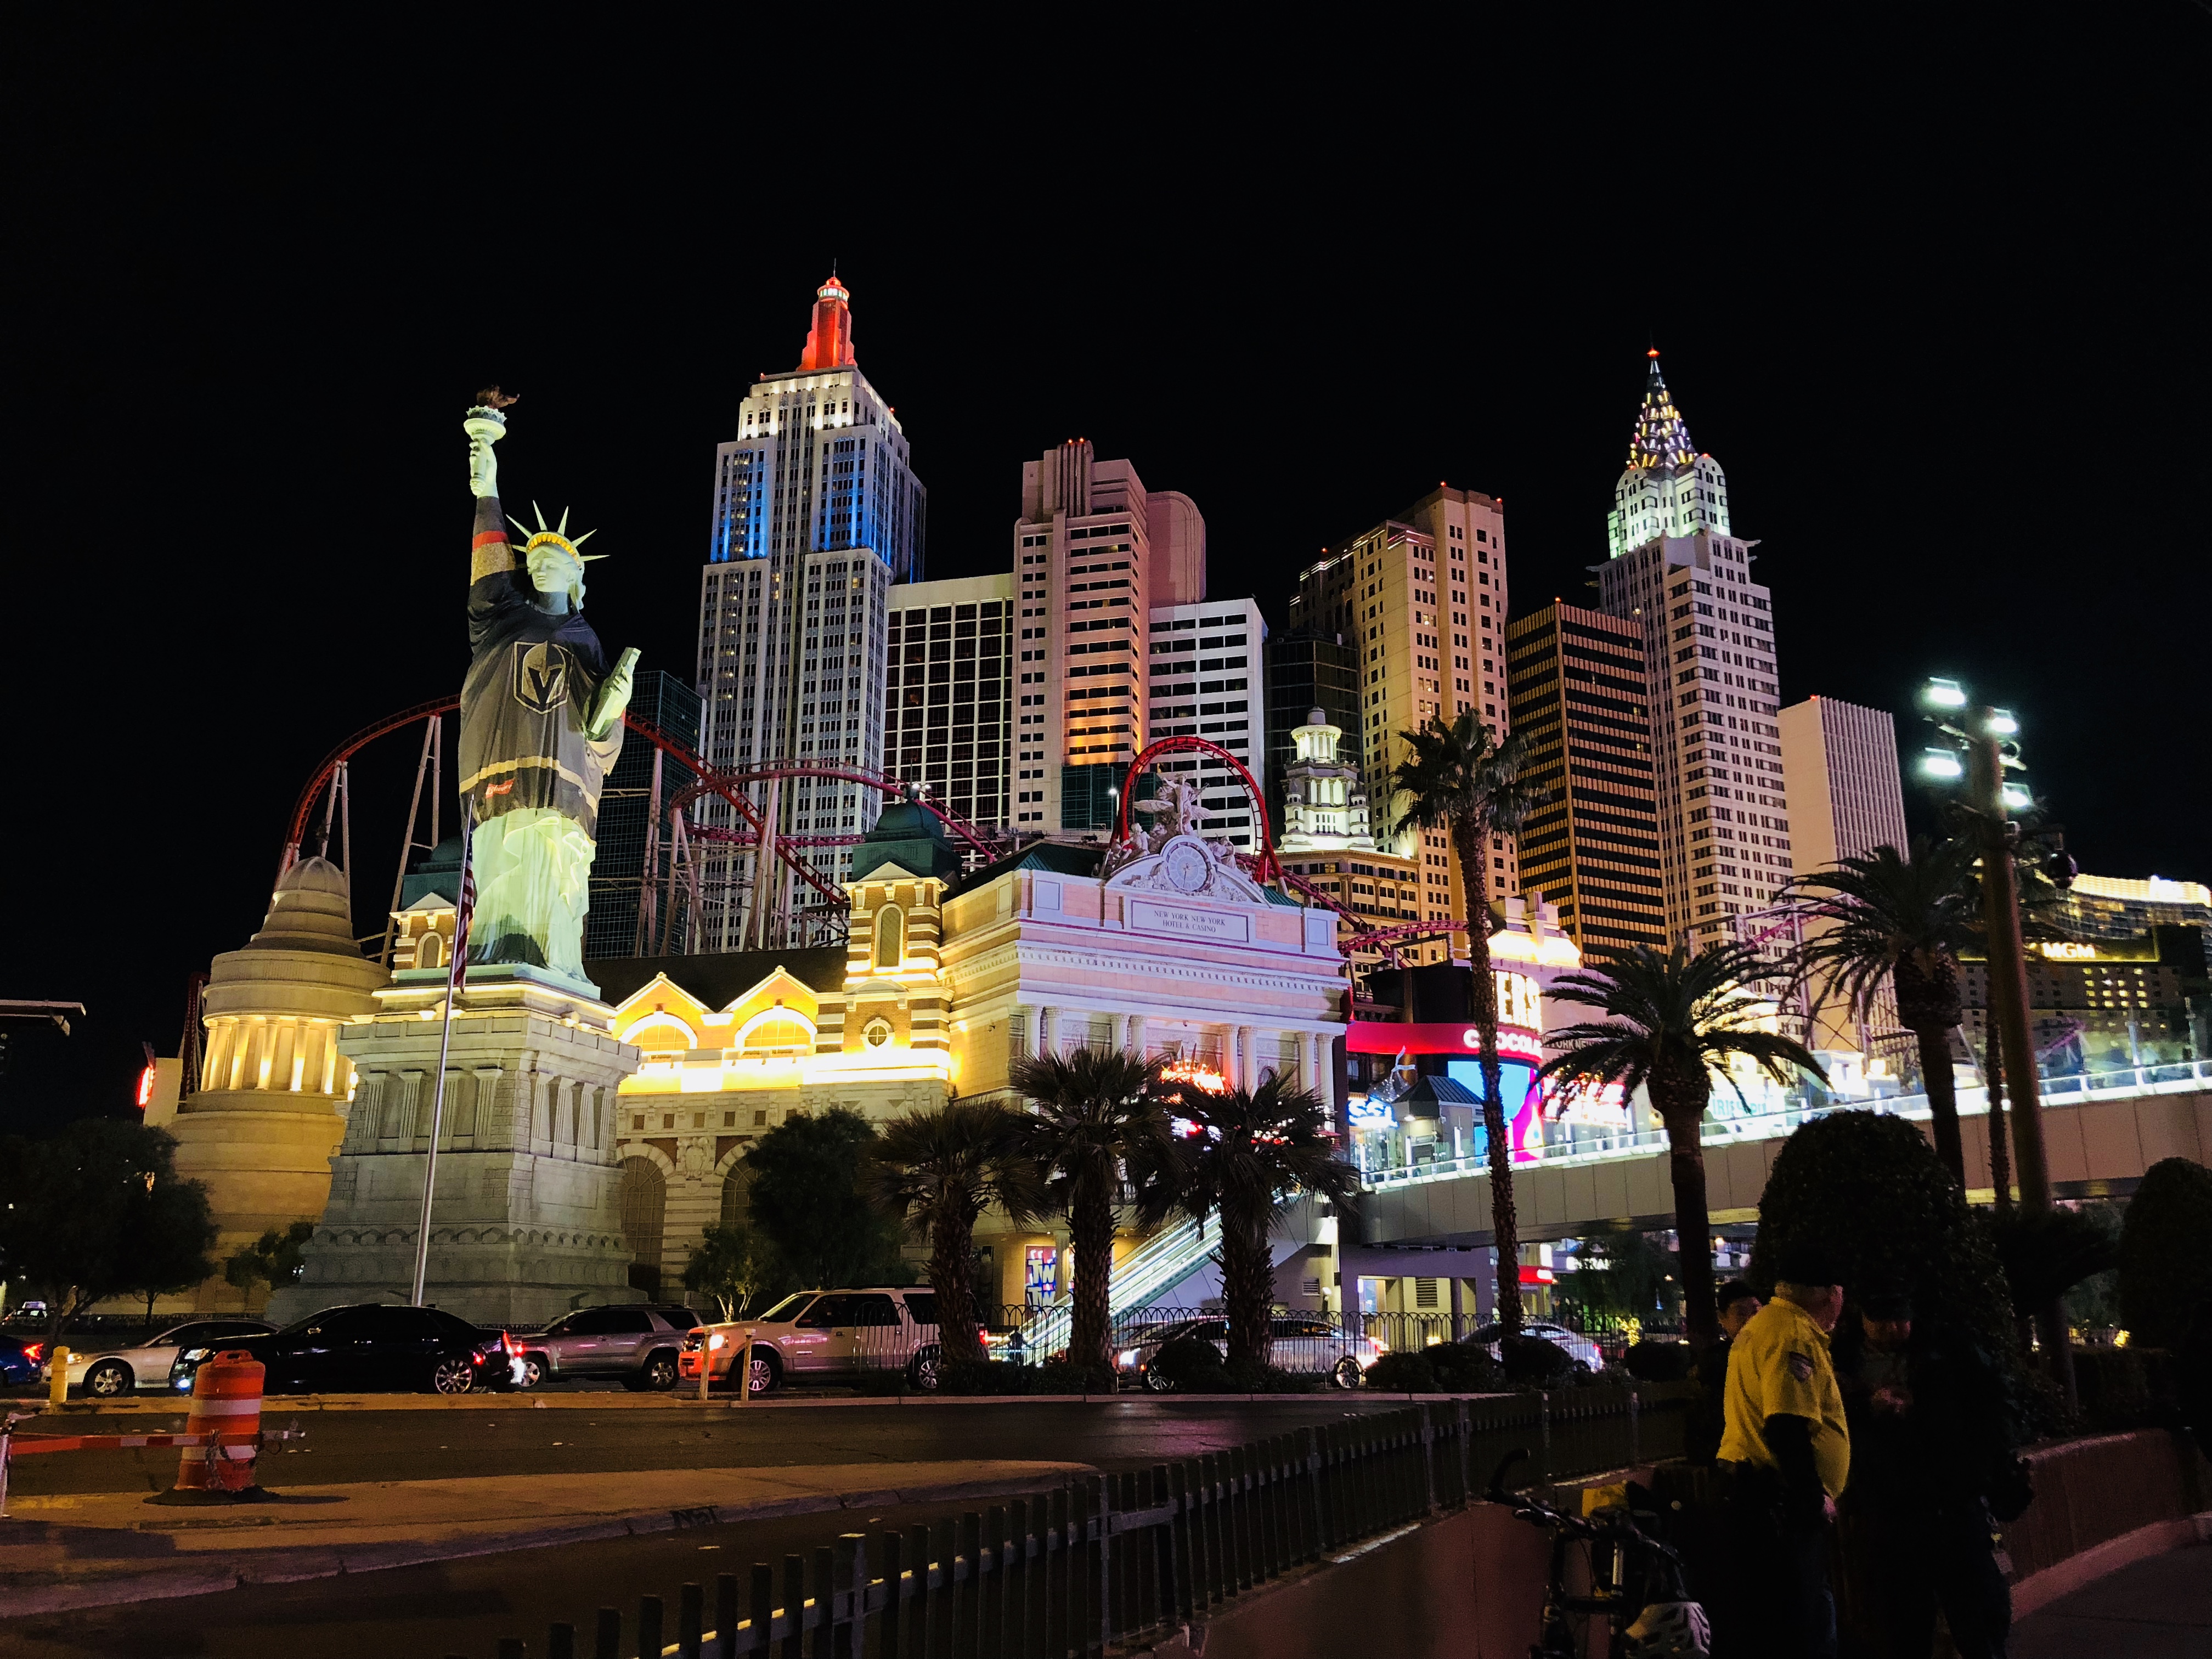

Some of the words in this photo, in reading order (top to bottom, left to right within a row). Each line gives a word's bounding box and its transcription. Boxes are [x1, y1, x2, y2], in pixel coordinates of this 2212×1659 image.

[1163, 919, 1184, 929] HOTEL
[1192, 924, 1216, 933] CASINO
[1171, 913, 1188, 921] YORK
[1208, 917, 1226, 926] YORK
[2042, 942, 2096, 958] MGM
